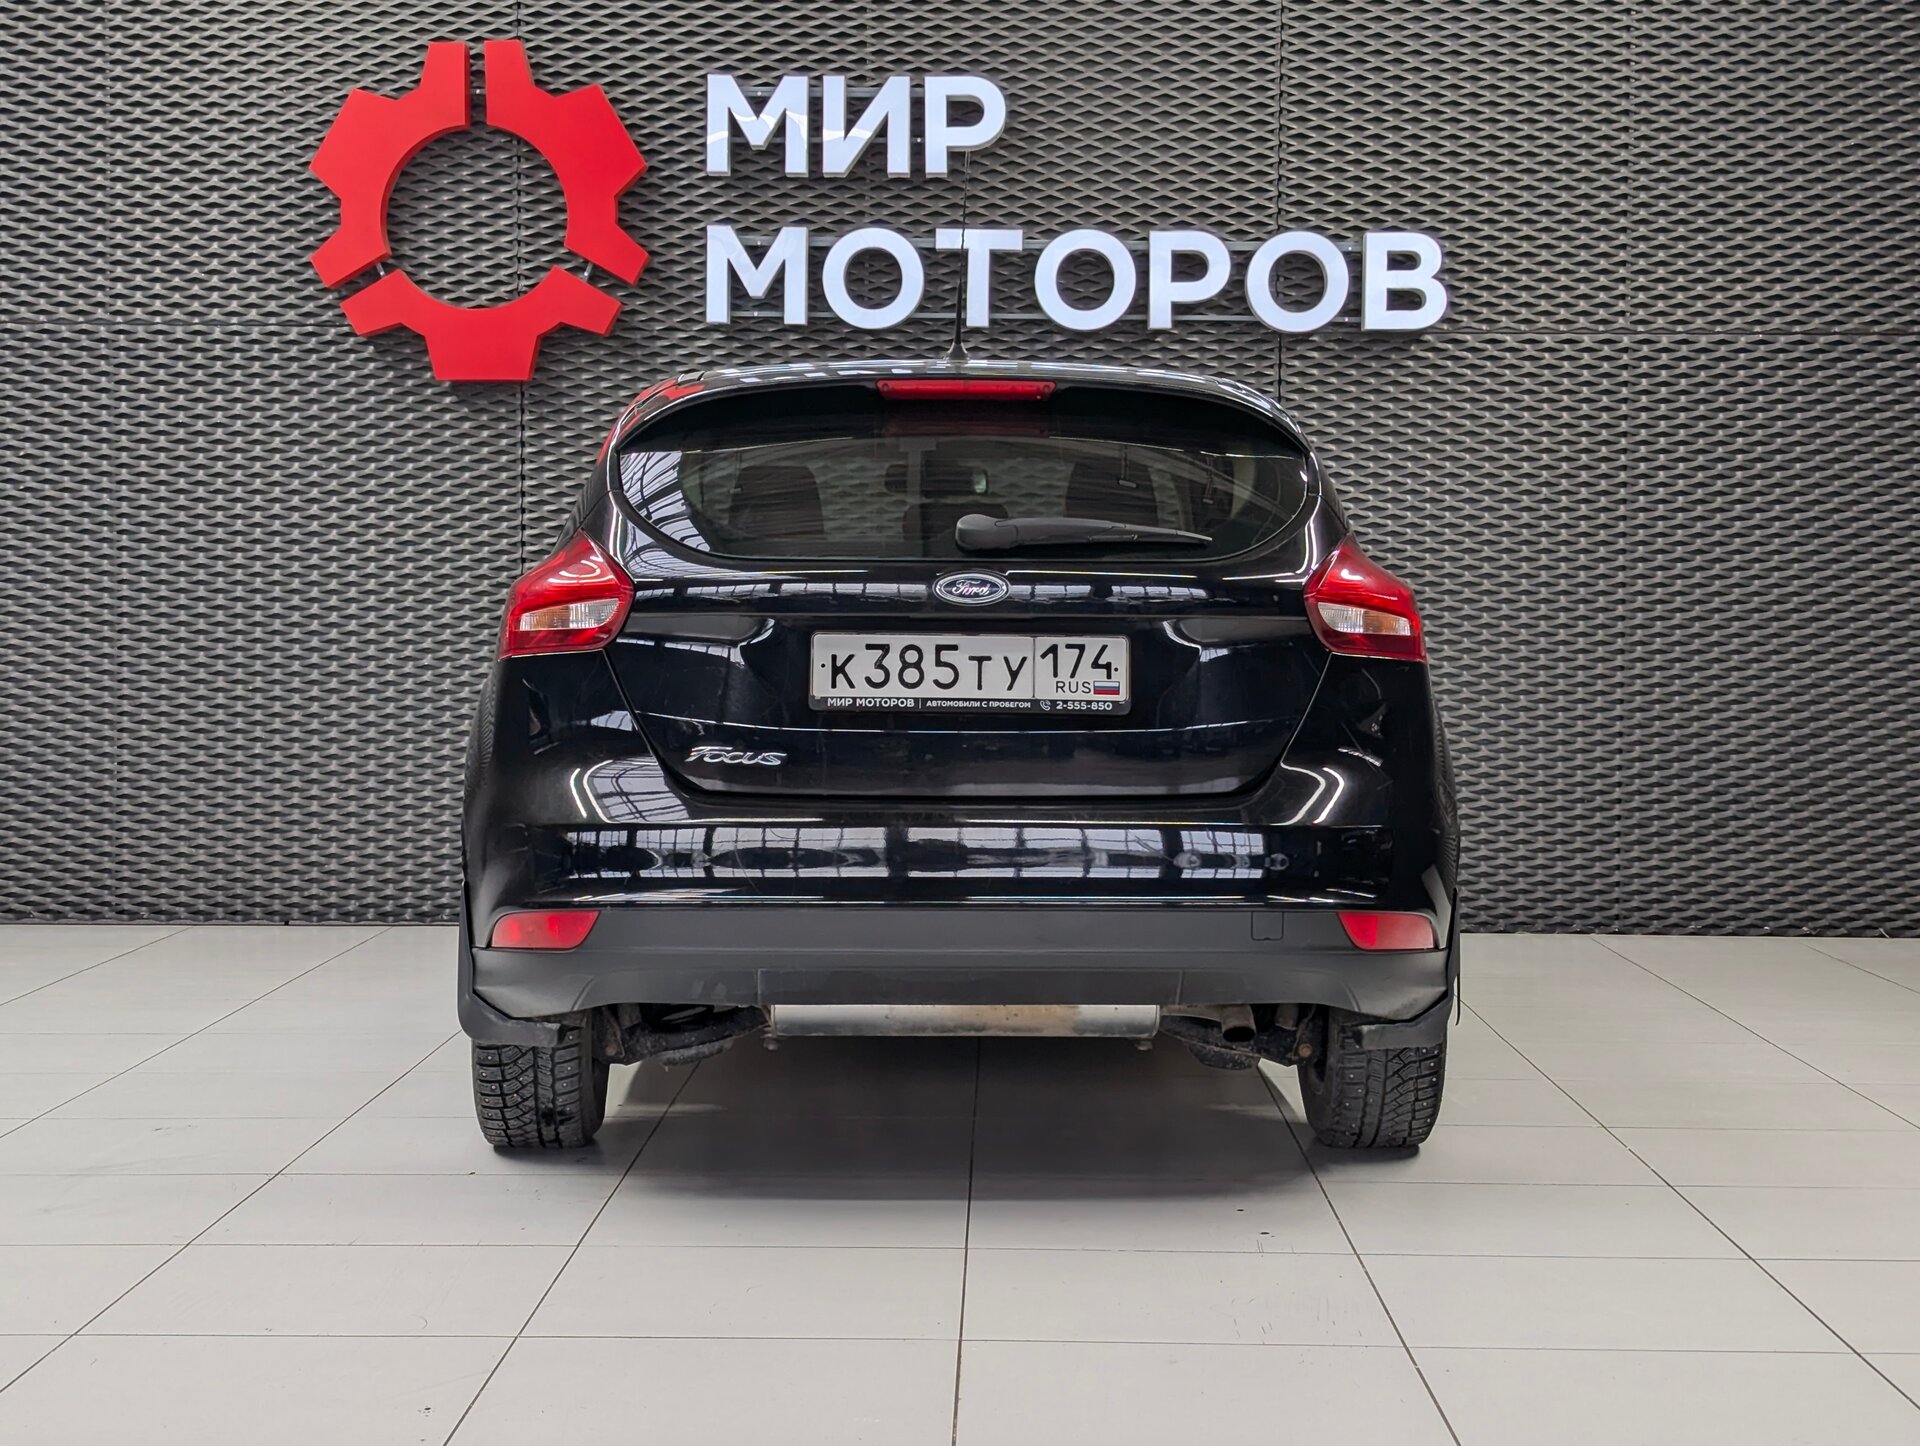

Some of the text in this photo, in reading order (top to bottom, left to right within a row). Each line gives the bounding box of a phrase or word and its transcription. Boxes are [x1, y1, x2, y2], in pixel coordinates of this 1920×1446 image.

[706, 74, 1007, 178] МИР
[705, 224, 1449, 332] МОТОРОВ
[951, 579, 991, 596] Ford
[830, 643, 1112, 691] К385ТУ 174
[1055, 680, 1092, 694] RUS
[827, 697, 853, 707] МИР
[856, 697, 915, 708] МОТОРОВ
[926, 700, 980, 708] АВТОМОБИЛИ
[989, 701, 1031, 709] ПРОБЕГОМ
[1056, 701, 1113, 711] 2-555-850
